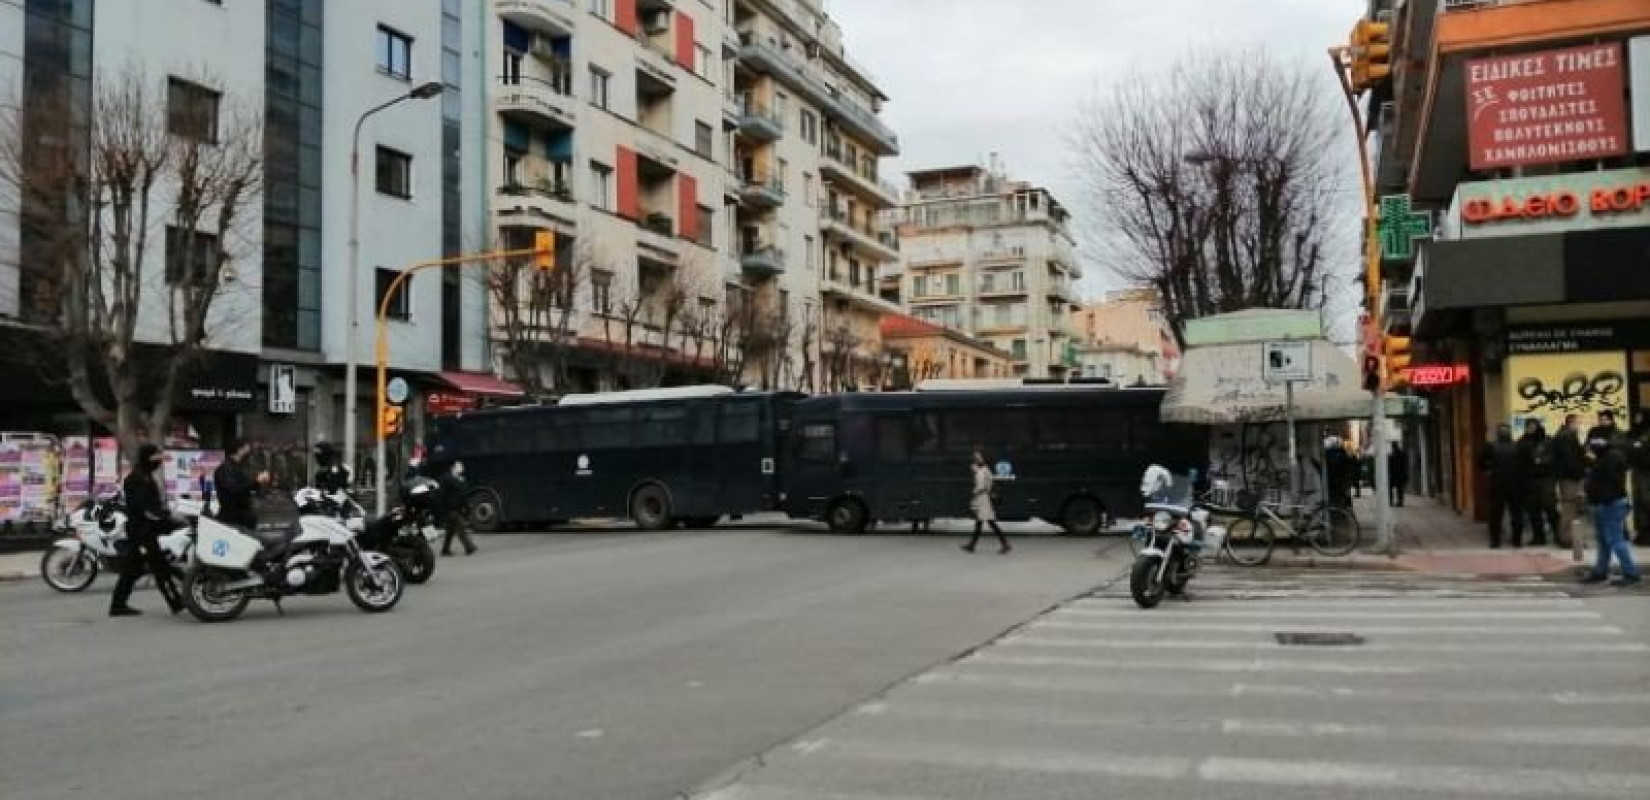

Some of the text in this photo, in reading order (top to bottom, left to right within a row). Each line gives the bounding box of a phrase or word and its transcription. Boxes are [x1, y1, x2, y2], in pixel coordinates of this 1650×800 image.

[1471, 47, 1617, 83] ΕΙΔΙΚΕΣ ΤΙΜΕΣ
[1473, 85, 1497, 104] ΣΕ
[1507, 81, 1586, 102] ΦΟΙΤΗΤΕΣ
[1499, 99, 1597, 123] ΣΠΟΥΔΑΣΤΕΣ
[1493, 118, 1606, 143] ΠΟΛΥΤΕΚΝΟΥΣ
